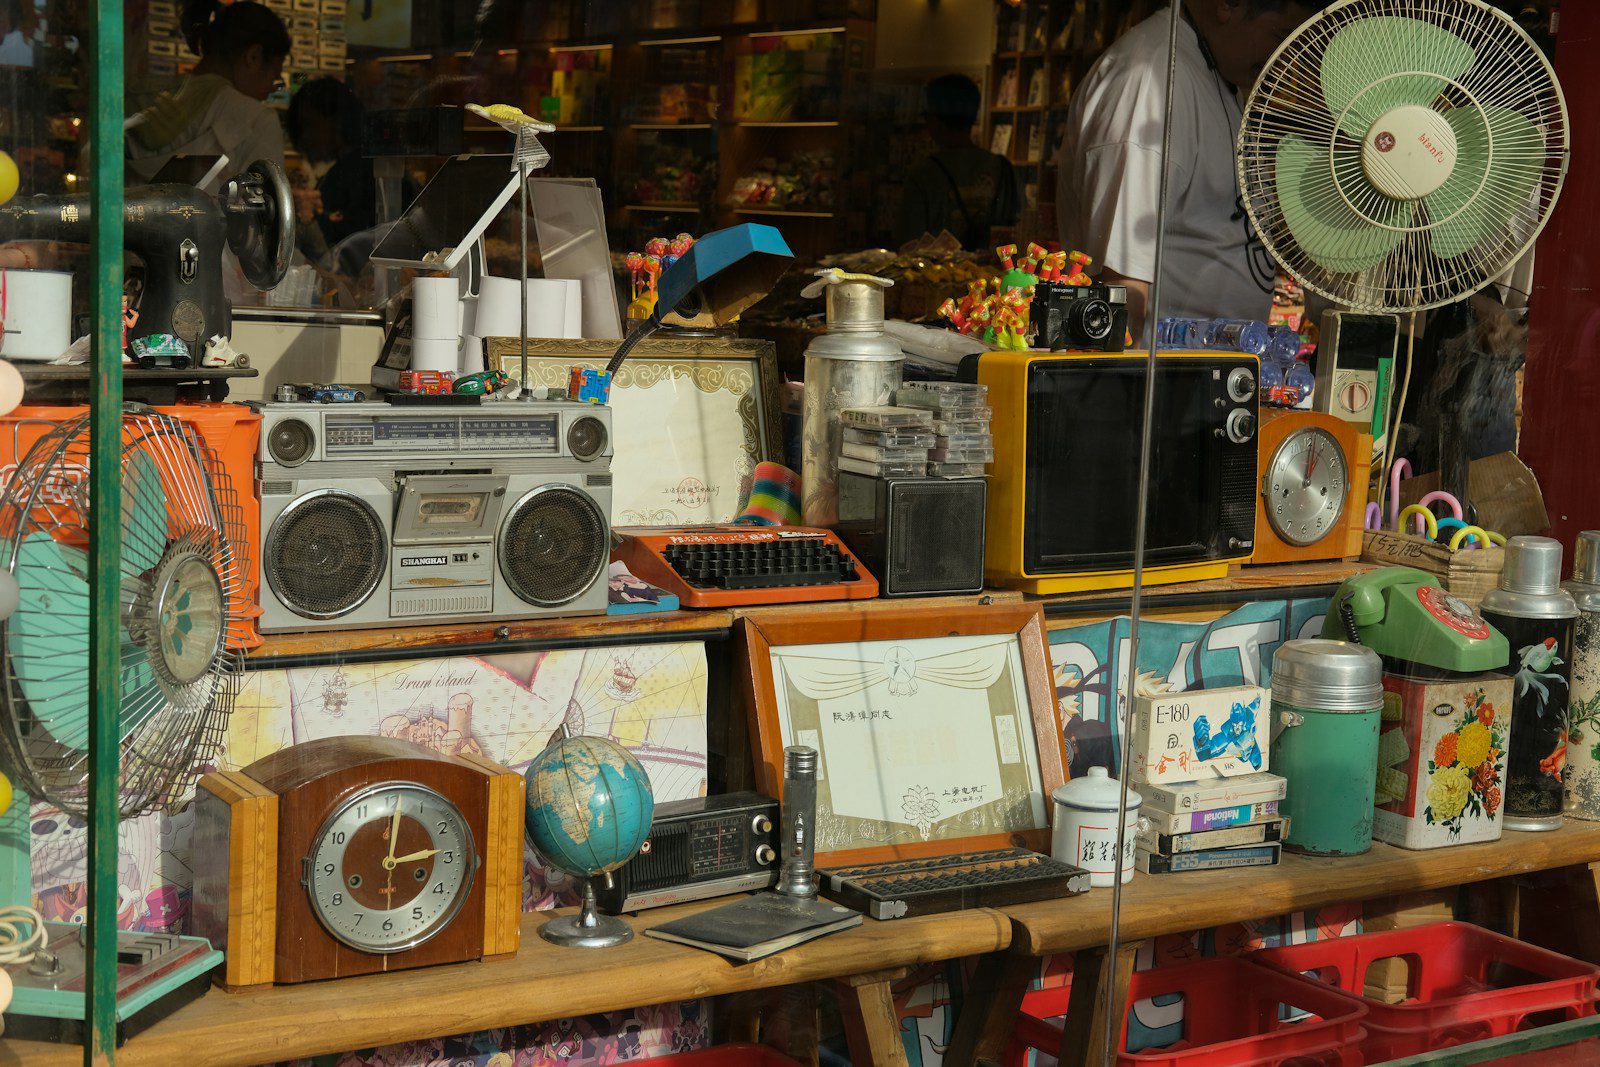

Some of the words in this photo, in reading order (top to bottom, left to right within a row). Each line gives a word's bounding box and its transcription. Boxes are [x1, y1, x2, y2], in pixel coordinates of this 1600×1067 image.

[1290, 443, 1299, 454] 11
[1303, 437, 1313, 448] 12
[1321, 442, 1325, 452] 1
[1277, 463, 1286, 472] 10
[1329, 457, 1336, 468] 2
[1273, 483, 1280, 494] 9
[1331, 479, 1339, 489] 3
[1276, 505, 1283, 515] 8
[1326, 501, 1333, 511] 4
[1286, 520, 1293, 530] 7
[1316, 517, 1322, 528] 5
[1301, 525, 1307, 535] 6
[401, 557, 447, 567] SHANGHAI
[392, 672, 432, 690] Drum
[435, 669, 478, 688] island
[1156, 703, 1190, 724] E-180
[356, 804, 368, 819] 11
[419, 800, 423, 814] 1
[1203, 808, 1240, 824] National
[437, 821, 448, 835] 2
[331, 831, 345, 845] 10
[443, 851, 453, 864] 3
[1171, 853, 1200, 869] F55
[324, 863, 335, 876] 9
[432, 882, 444, 895] 4
[332, 893, 343, 906] 8
[412, 906, 423, 920] 5
[353, 913, 364, 927] 7
[382, 918, 393, 931] 6
